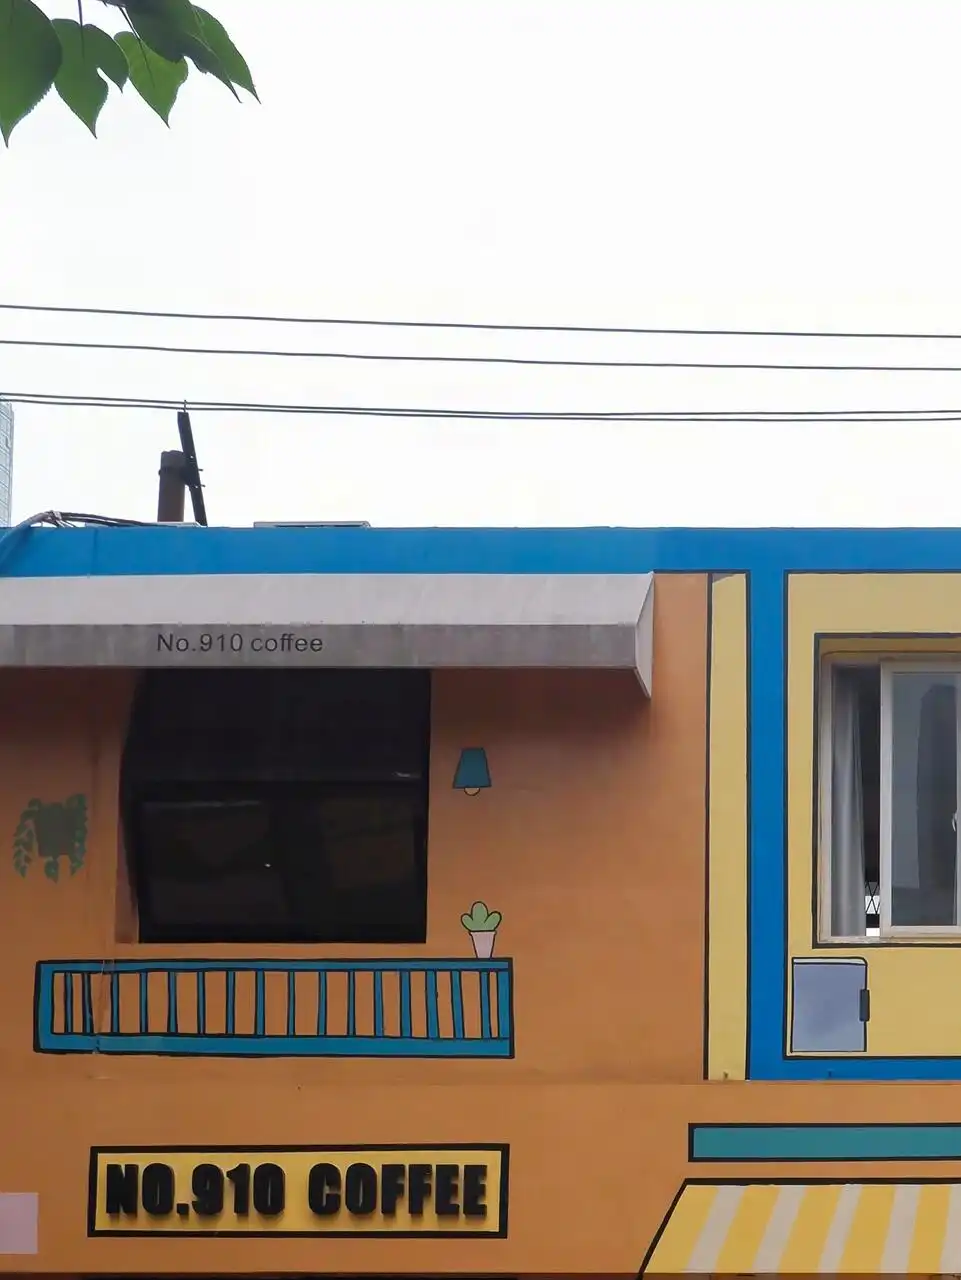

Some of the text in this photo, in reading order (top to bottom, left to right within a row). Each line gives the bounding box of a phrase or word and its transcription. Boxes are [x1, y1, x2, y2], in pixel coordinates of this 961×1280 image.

[156, 632, 324, 653] No.910 coffee
[105, 1162, 489, 1217] NO.910 COFFEE
